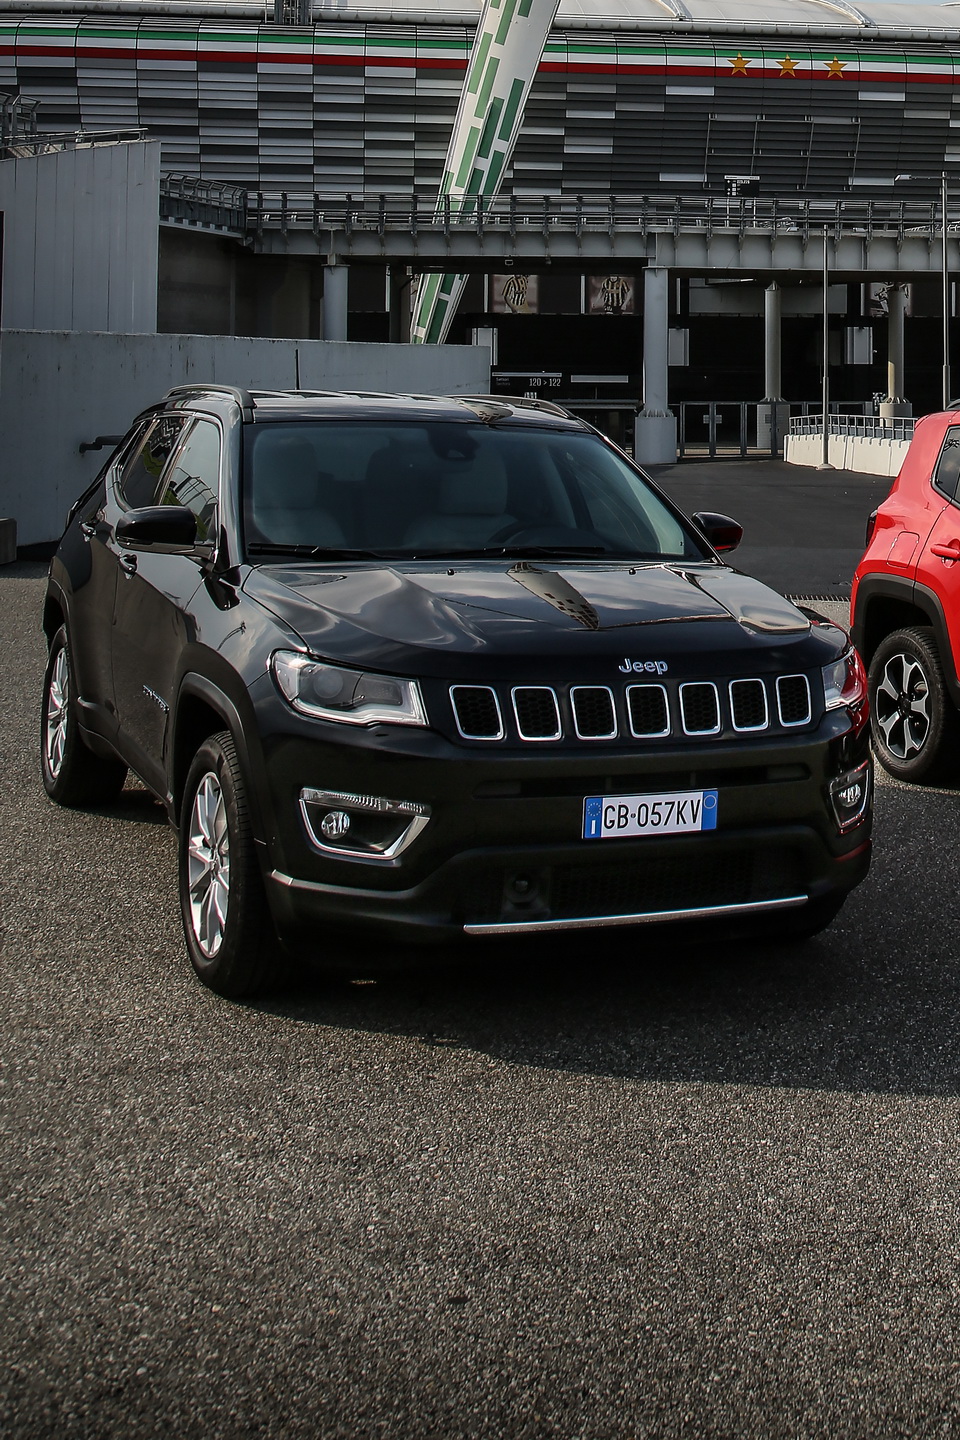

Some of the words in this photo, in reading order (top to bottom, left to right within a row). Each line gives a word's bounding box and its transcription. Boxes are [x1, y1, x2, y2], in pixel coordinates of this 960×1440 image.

[529, 378, 541, 387] 120
[549, 378, 561, 387] 122
[618, 658, 669, 675] Jeep
